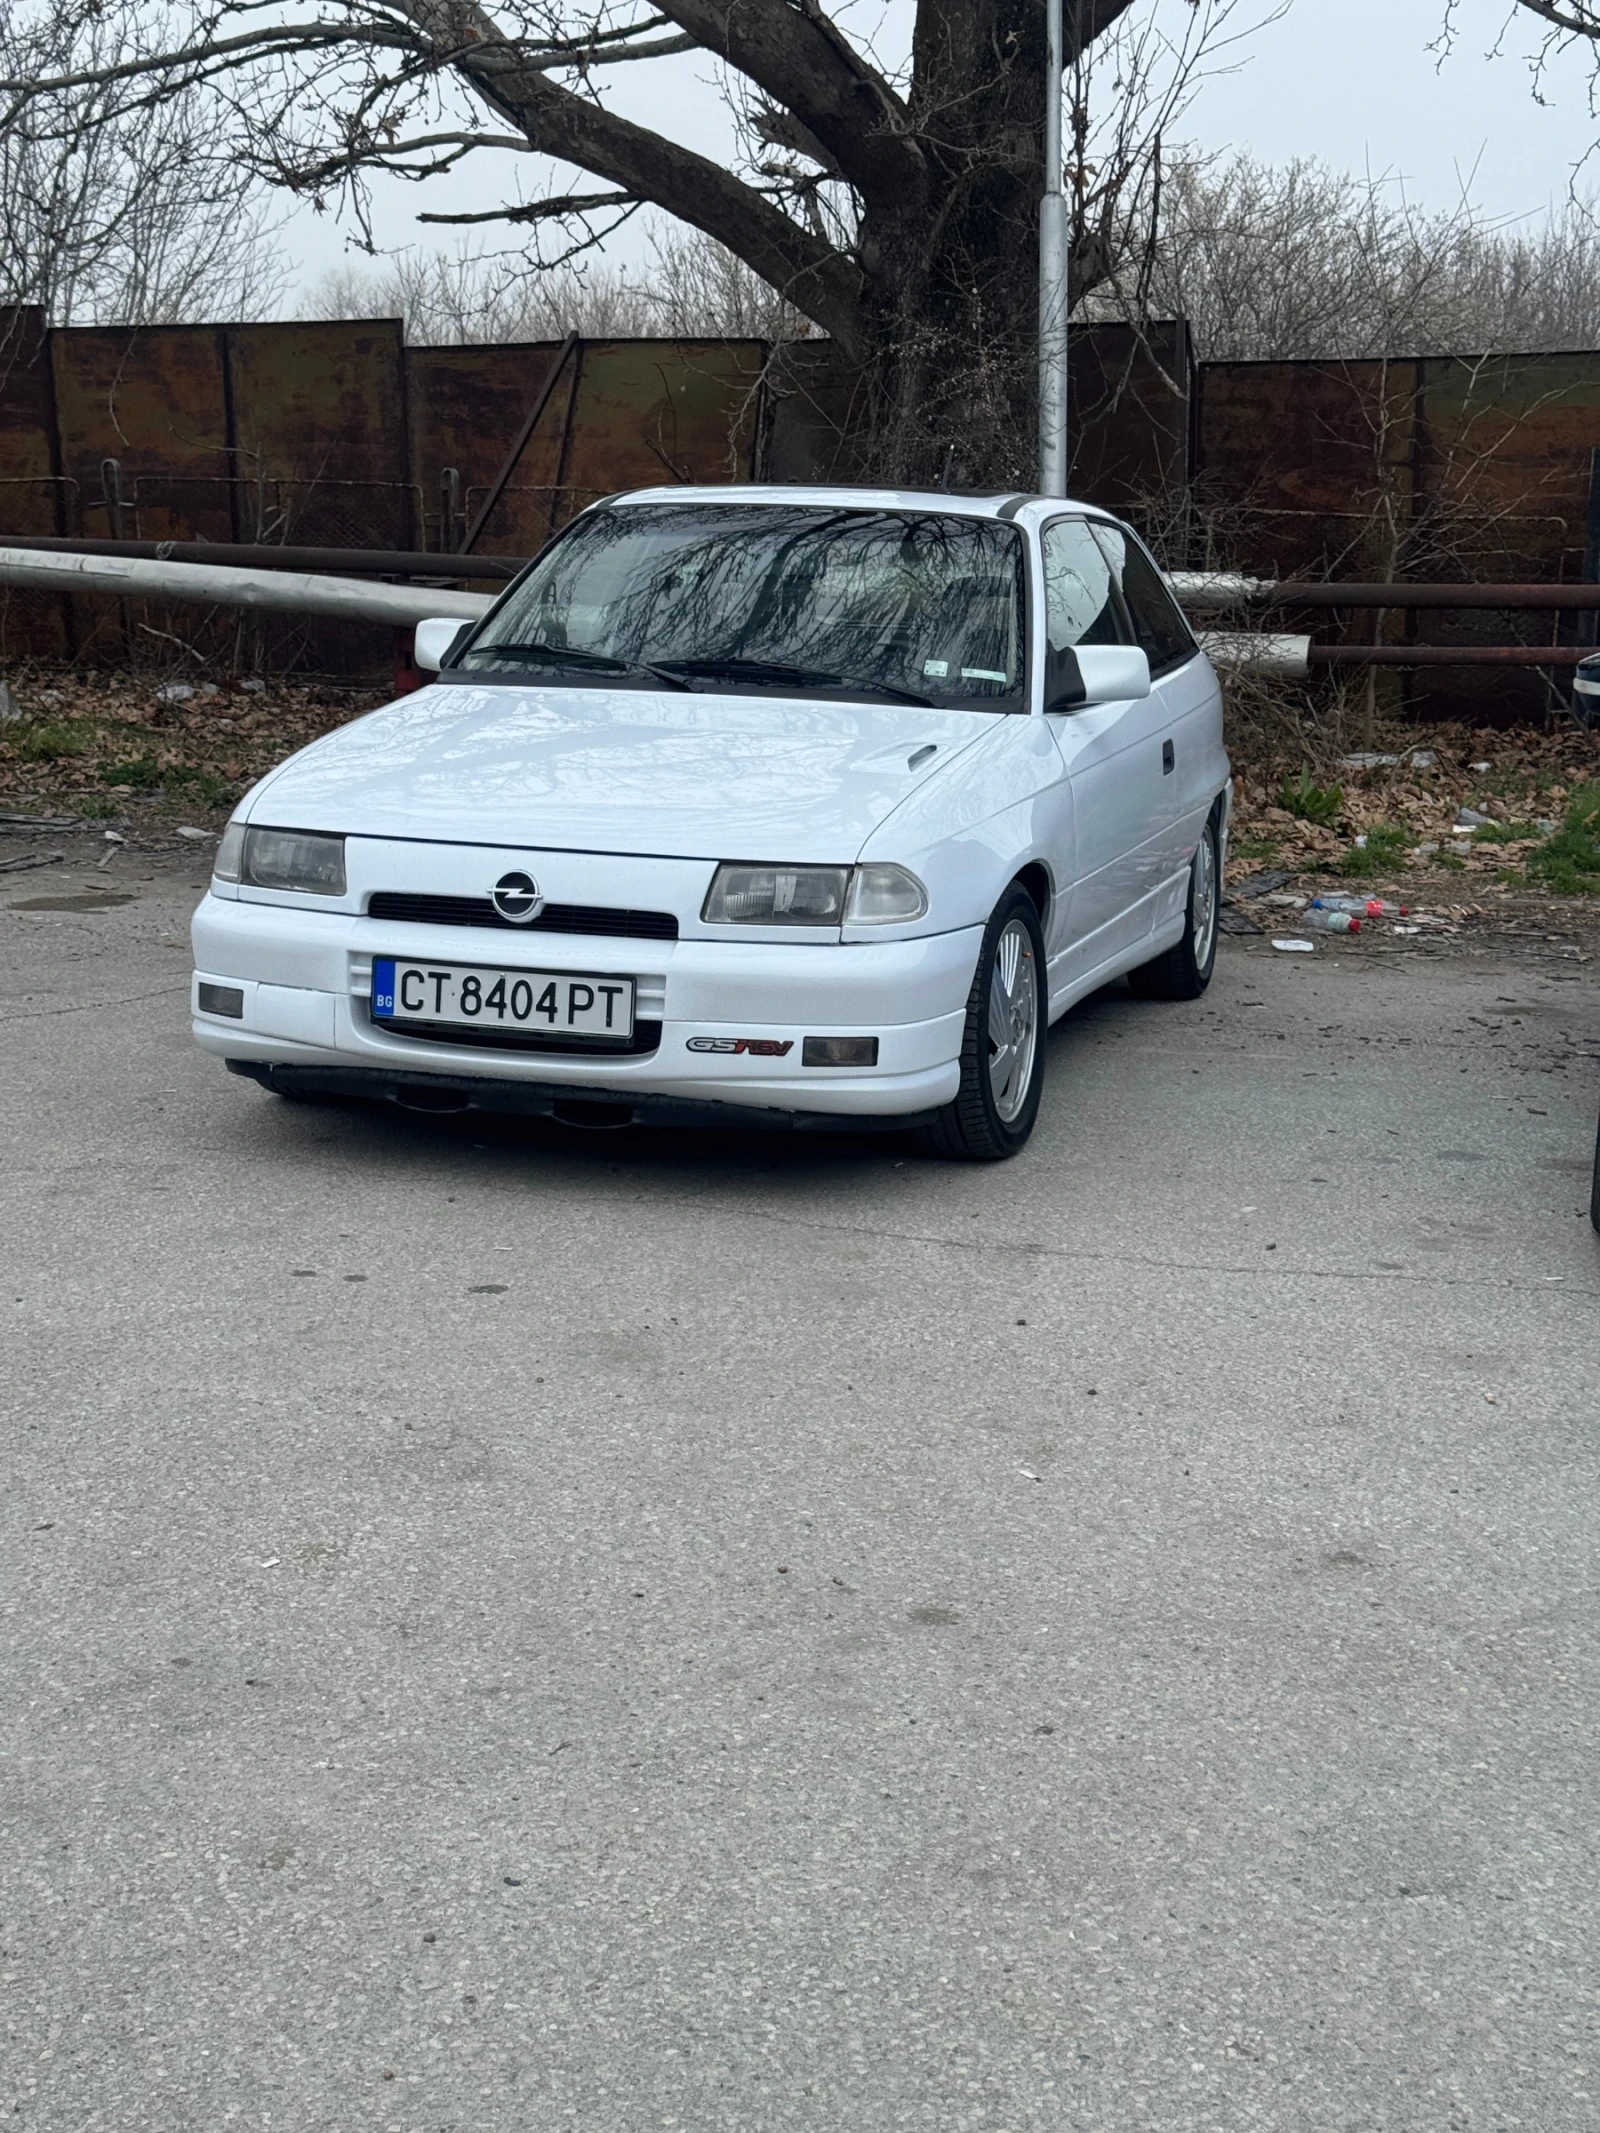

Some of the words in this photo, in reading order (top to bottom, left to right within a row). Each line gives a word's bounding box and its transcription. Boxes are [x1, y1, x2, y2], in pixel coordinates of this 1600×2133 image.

[377, 994, 393, 1008] BG
[401, 969, 452, 1014] CT
[460, 975, 558, 1024] 8404
[567, 982, 624, 1028] PT
